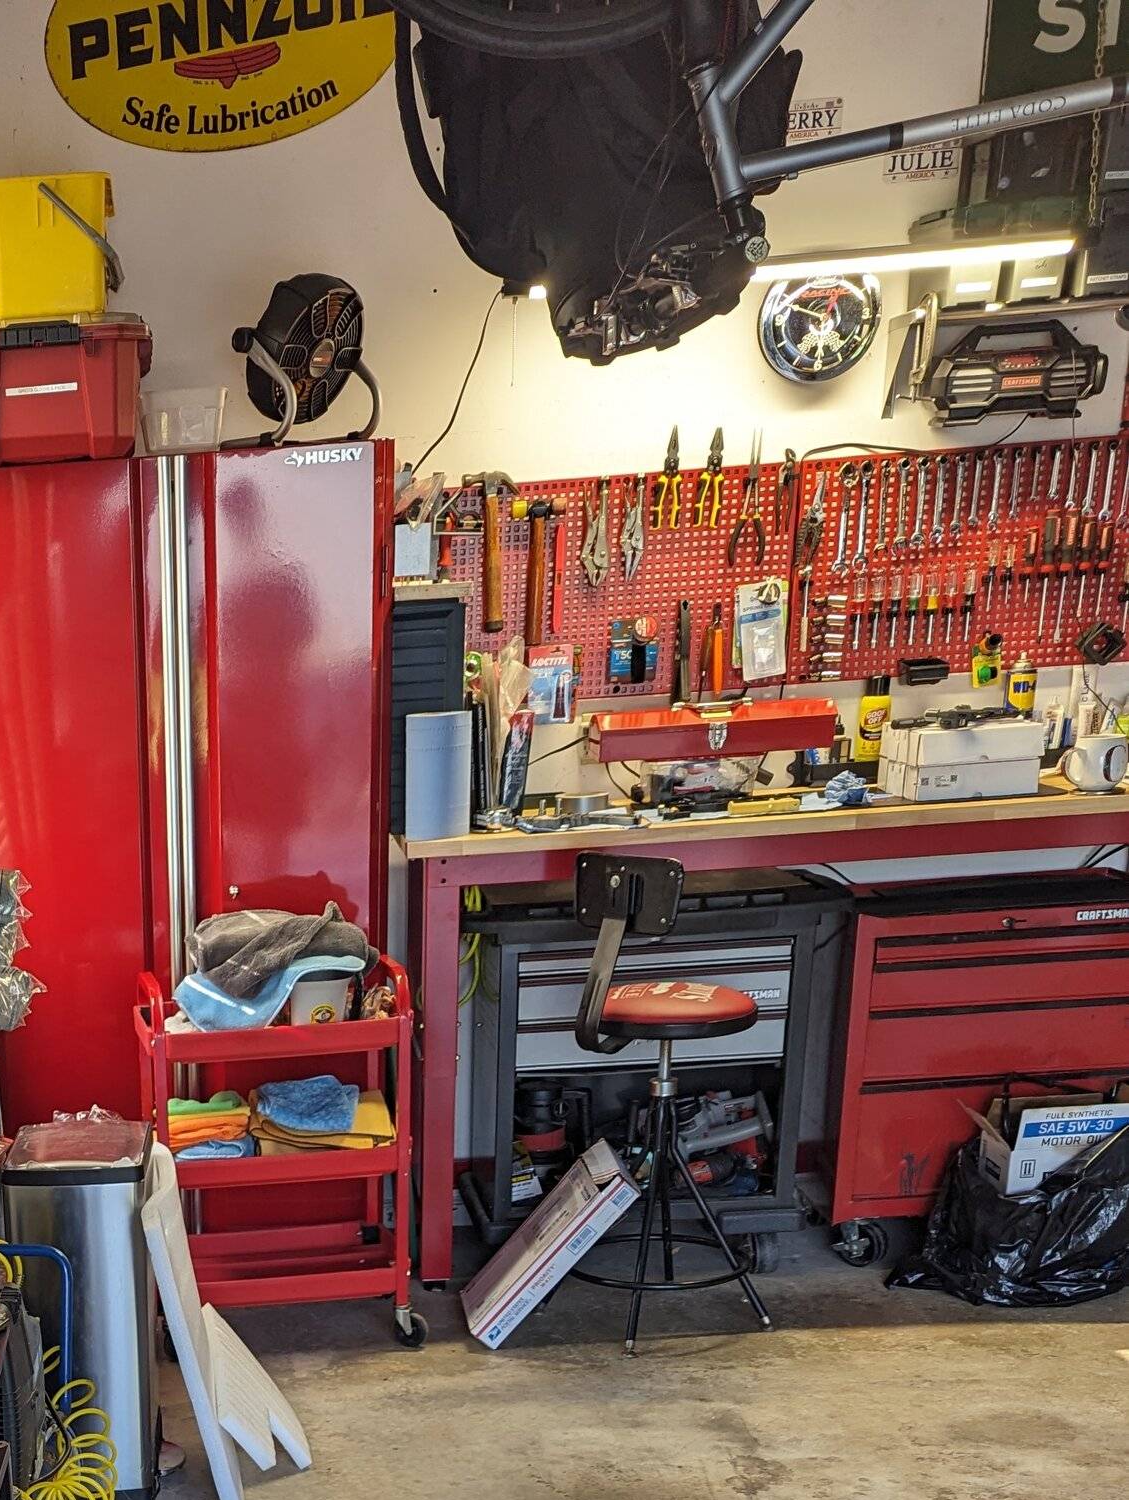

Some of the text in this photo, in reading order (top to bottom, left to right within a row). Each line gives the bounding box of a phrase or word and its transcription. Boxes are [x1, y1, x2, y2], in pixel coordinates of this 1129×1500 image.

[122, 79, 339, 135] Safe Lubrication
[950, 96, 1067, 132] CODA ELITE
[888, 150, 954, 173] JULIE
[905, 170, 935, 180] AMERICA
[862, 307, 872, 320] 3
[774, 314, 784, 327] 9
[813, 360, 823, 372] 6
[305, 447, 364, 465] HUSKY
[531, 656, 569, 667] LOCTITE
[1045, 1109, 1114, 1120] FULL SYNTHETIC
[1039, 1119, 1115, 1134] SAE 5W-30
[1041, 1135, 1081, 1147] MOTOR
